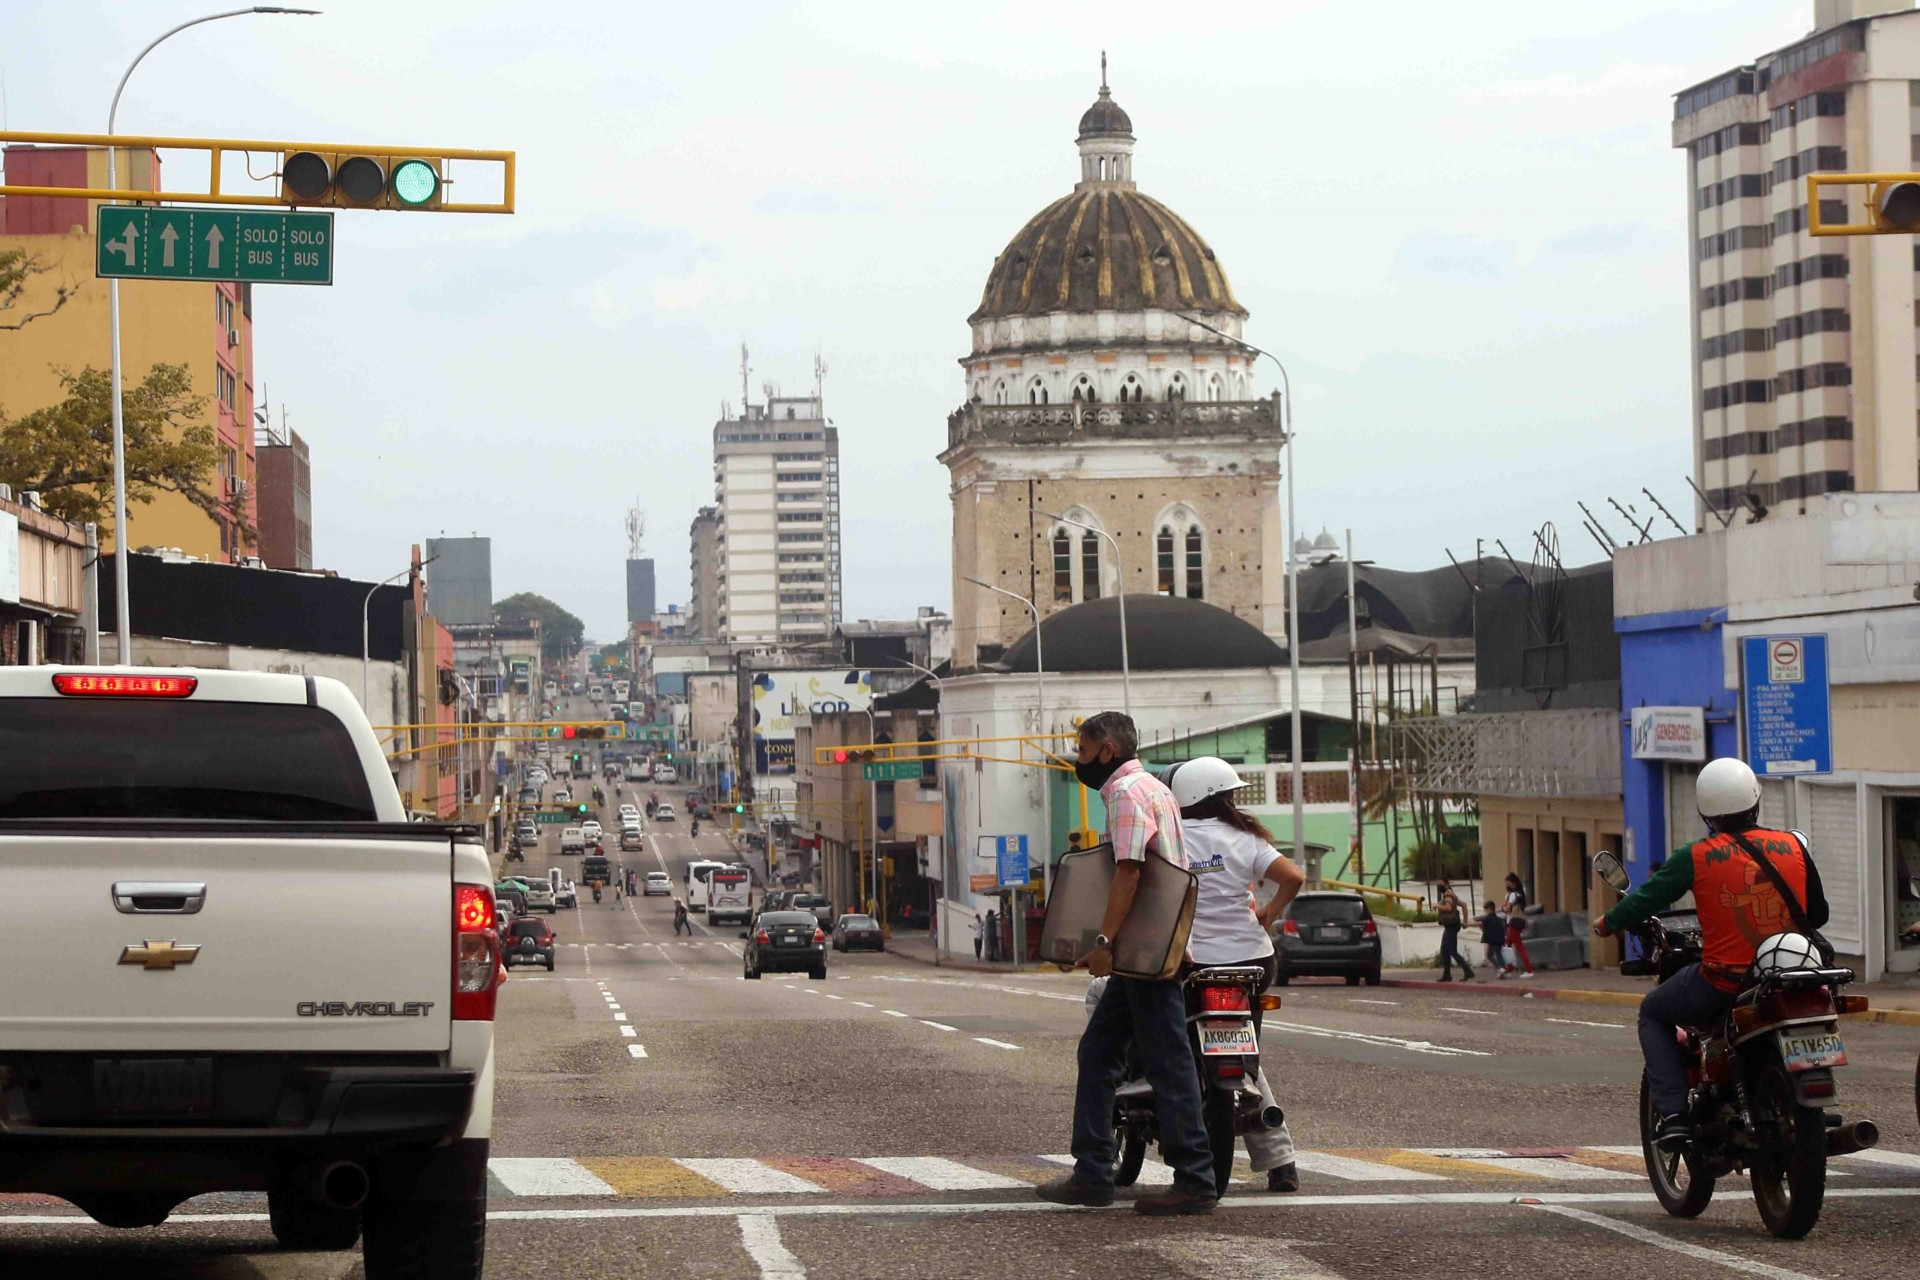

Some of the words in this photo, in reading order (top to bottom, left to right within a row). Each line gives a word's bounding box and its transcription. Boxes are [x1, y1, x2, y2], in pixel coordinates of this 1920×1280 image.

[244, 229, 278, 243] SOLO
[291, 231, 324, 245] SOLO
[248, 251, 273, 265] BUS
[294, 252, 319, 266] BUS
[1757, 692, 1795, 700] CORDERO
[1758, 722, 1795, 730] LIBERTAD
[297, 1001, 435, 1016] CHEVROLET
